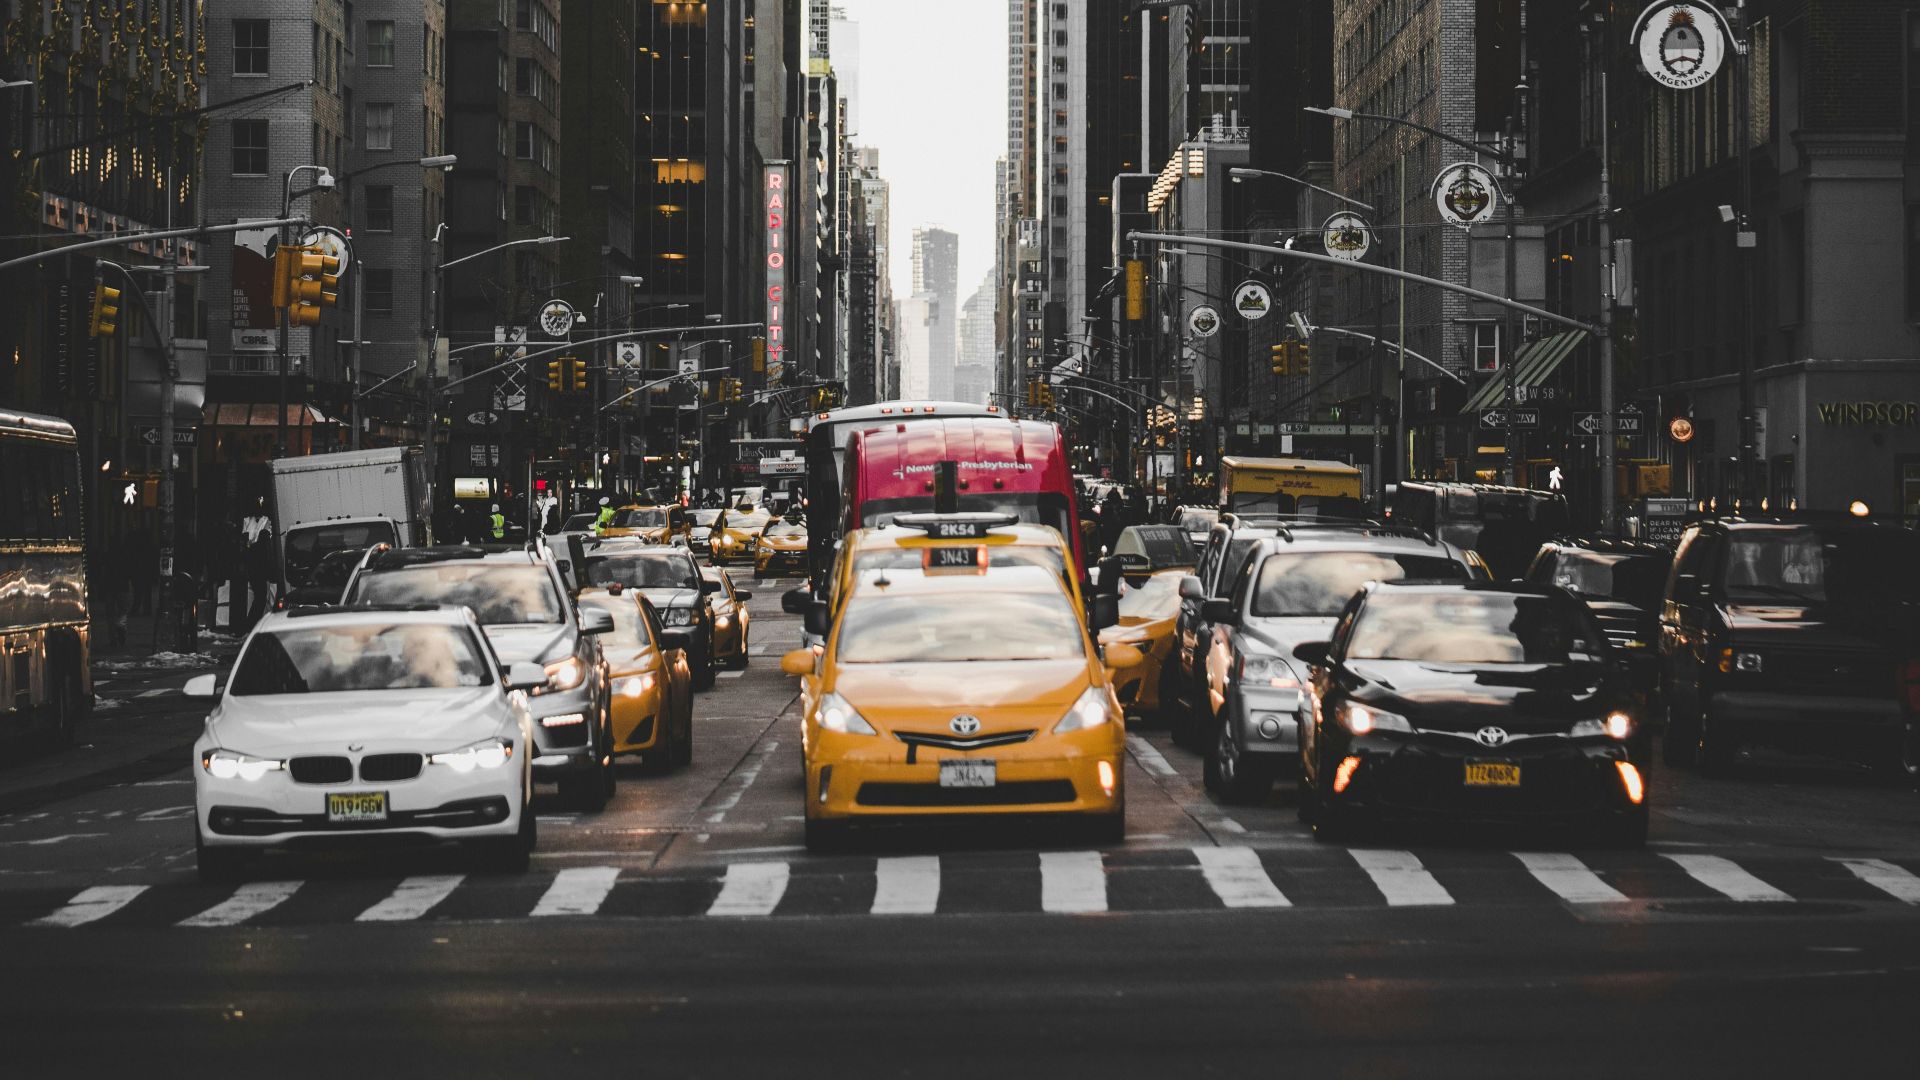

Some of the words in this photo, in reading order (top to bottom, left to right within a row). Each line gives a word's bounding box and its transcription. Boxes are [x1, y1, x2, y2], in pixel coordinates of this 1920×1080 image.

[1653, 70, 1711, 87] ARGENTINA
[767, 173, 784, 269] RADIO
[1447, 216, 1471, 227] COSTA
[767, 285, 784, 361] CITY
[241, 335, 268, 345] CBRE
[1529, 387, 1538, 399] W
[1542, 387, 1554, 399] 58
[1514, 413, 1534, 424] WAY
[1817, 401, 1919, 425] WINDSOR
[1660, 503, 1685, 512] TITAN
[939, 524, 976, 537] 2K54
[939, 548, 970, 565] 3N43
